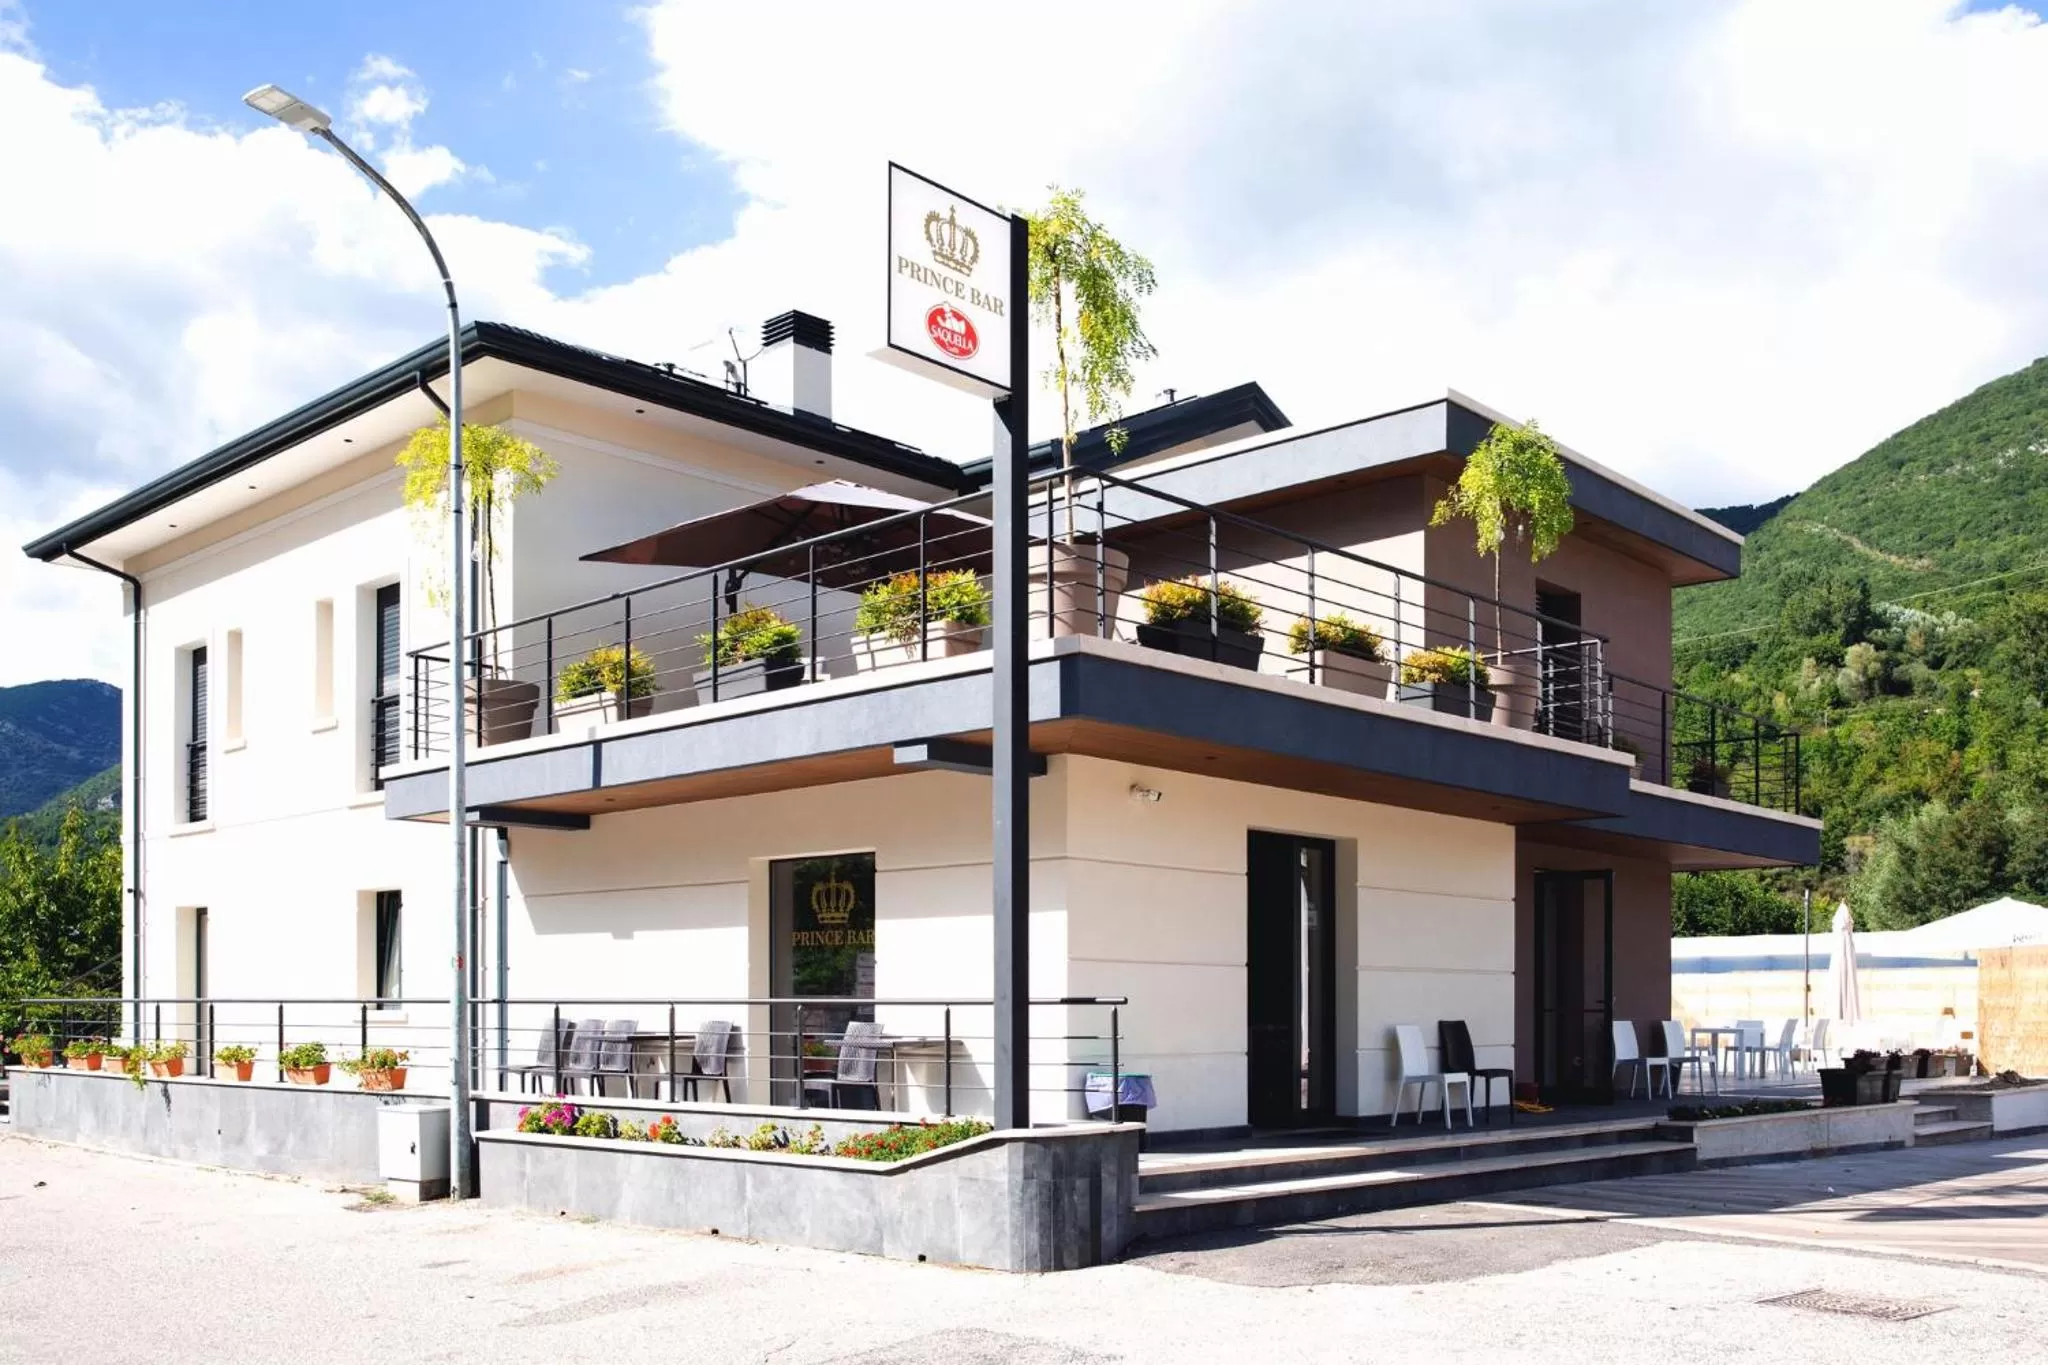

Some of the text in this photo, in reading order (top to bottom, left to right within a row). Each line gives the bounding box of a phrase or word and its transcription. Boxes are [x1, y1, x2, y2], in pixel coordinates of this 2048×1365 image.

[897, 255, 1005, 317] PRINCE BAR
[931, 324, 974, 352] SAQUELLA
[792, 929, 875, 947] PRINCE BAR
